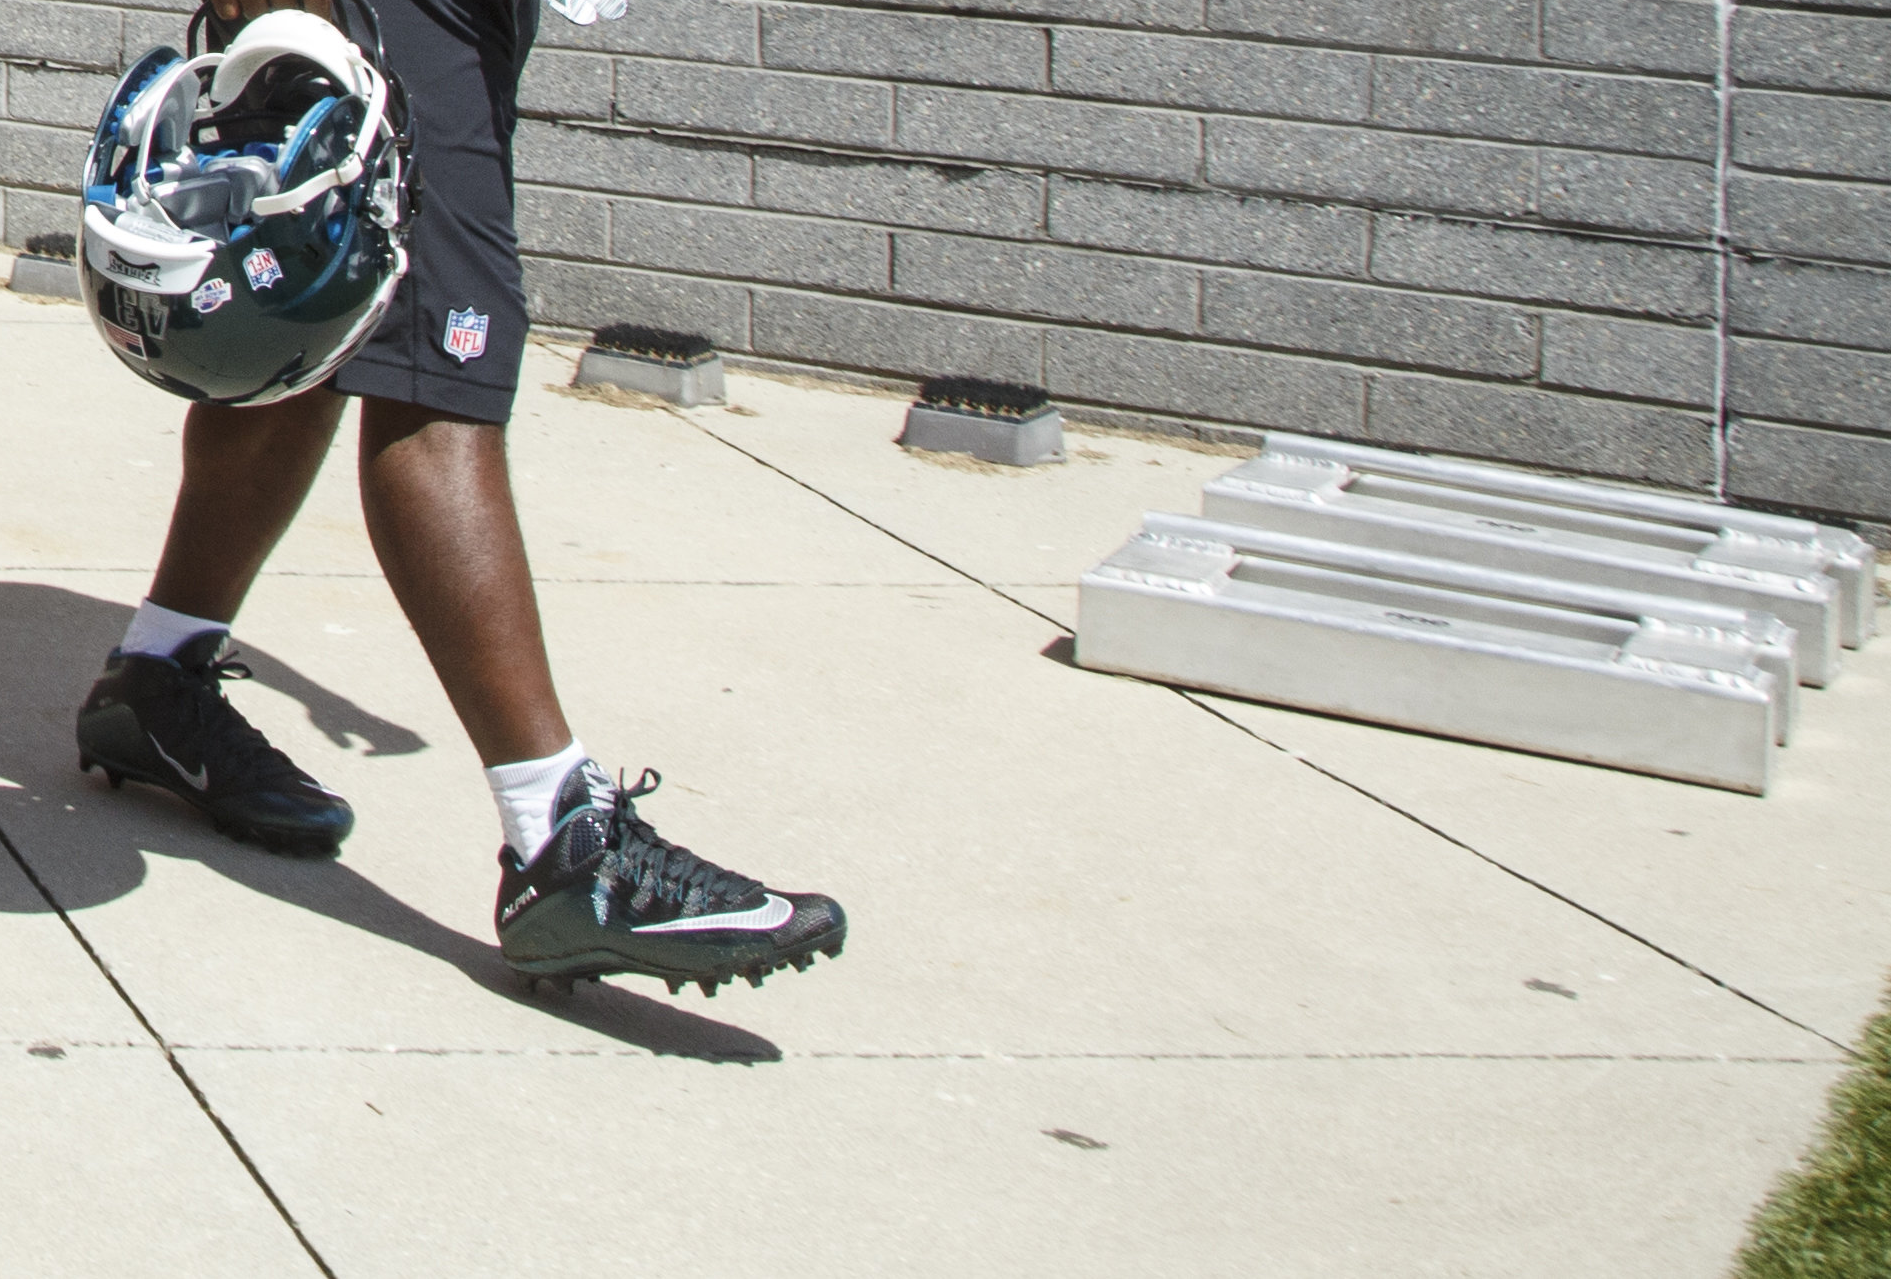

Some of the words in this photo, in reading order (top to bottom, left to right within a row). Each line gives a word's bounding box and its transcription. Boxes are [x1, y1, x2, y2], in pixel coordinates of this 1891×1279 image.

[106, 250, 161, 287] EAGLES
[247, 251, 275, 277] NFL
[449, 328, 481, 353] NFL
